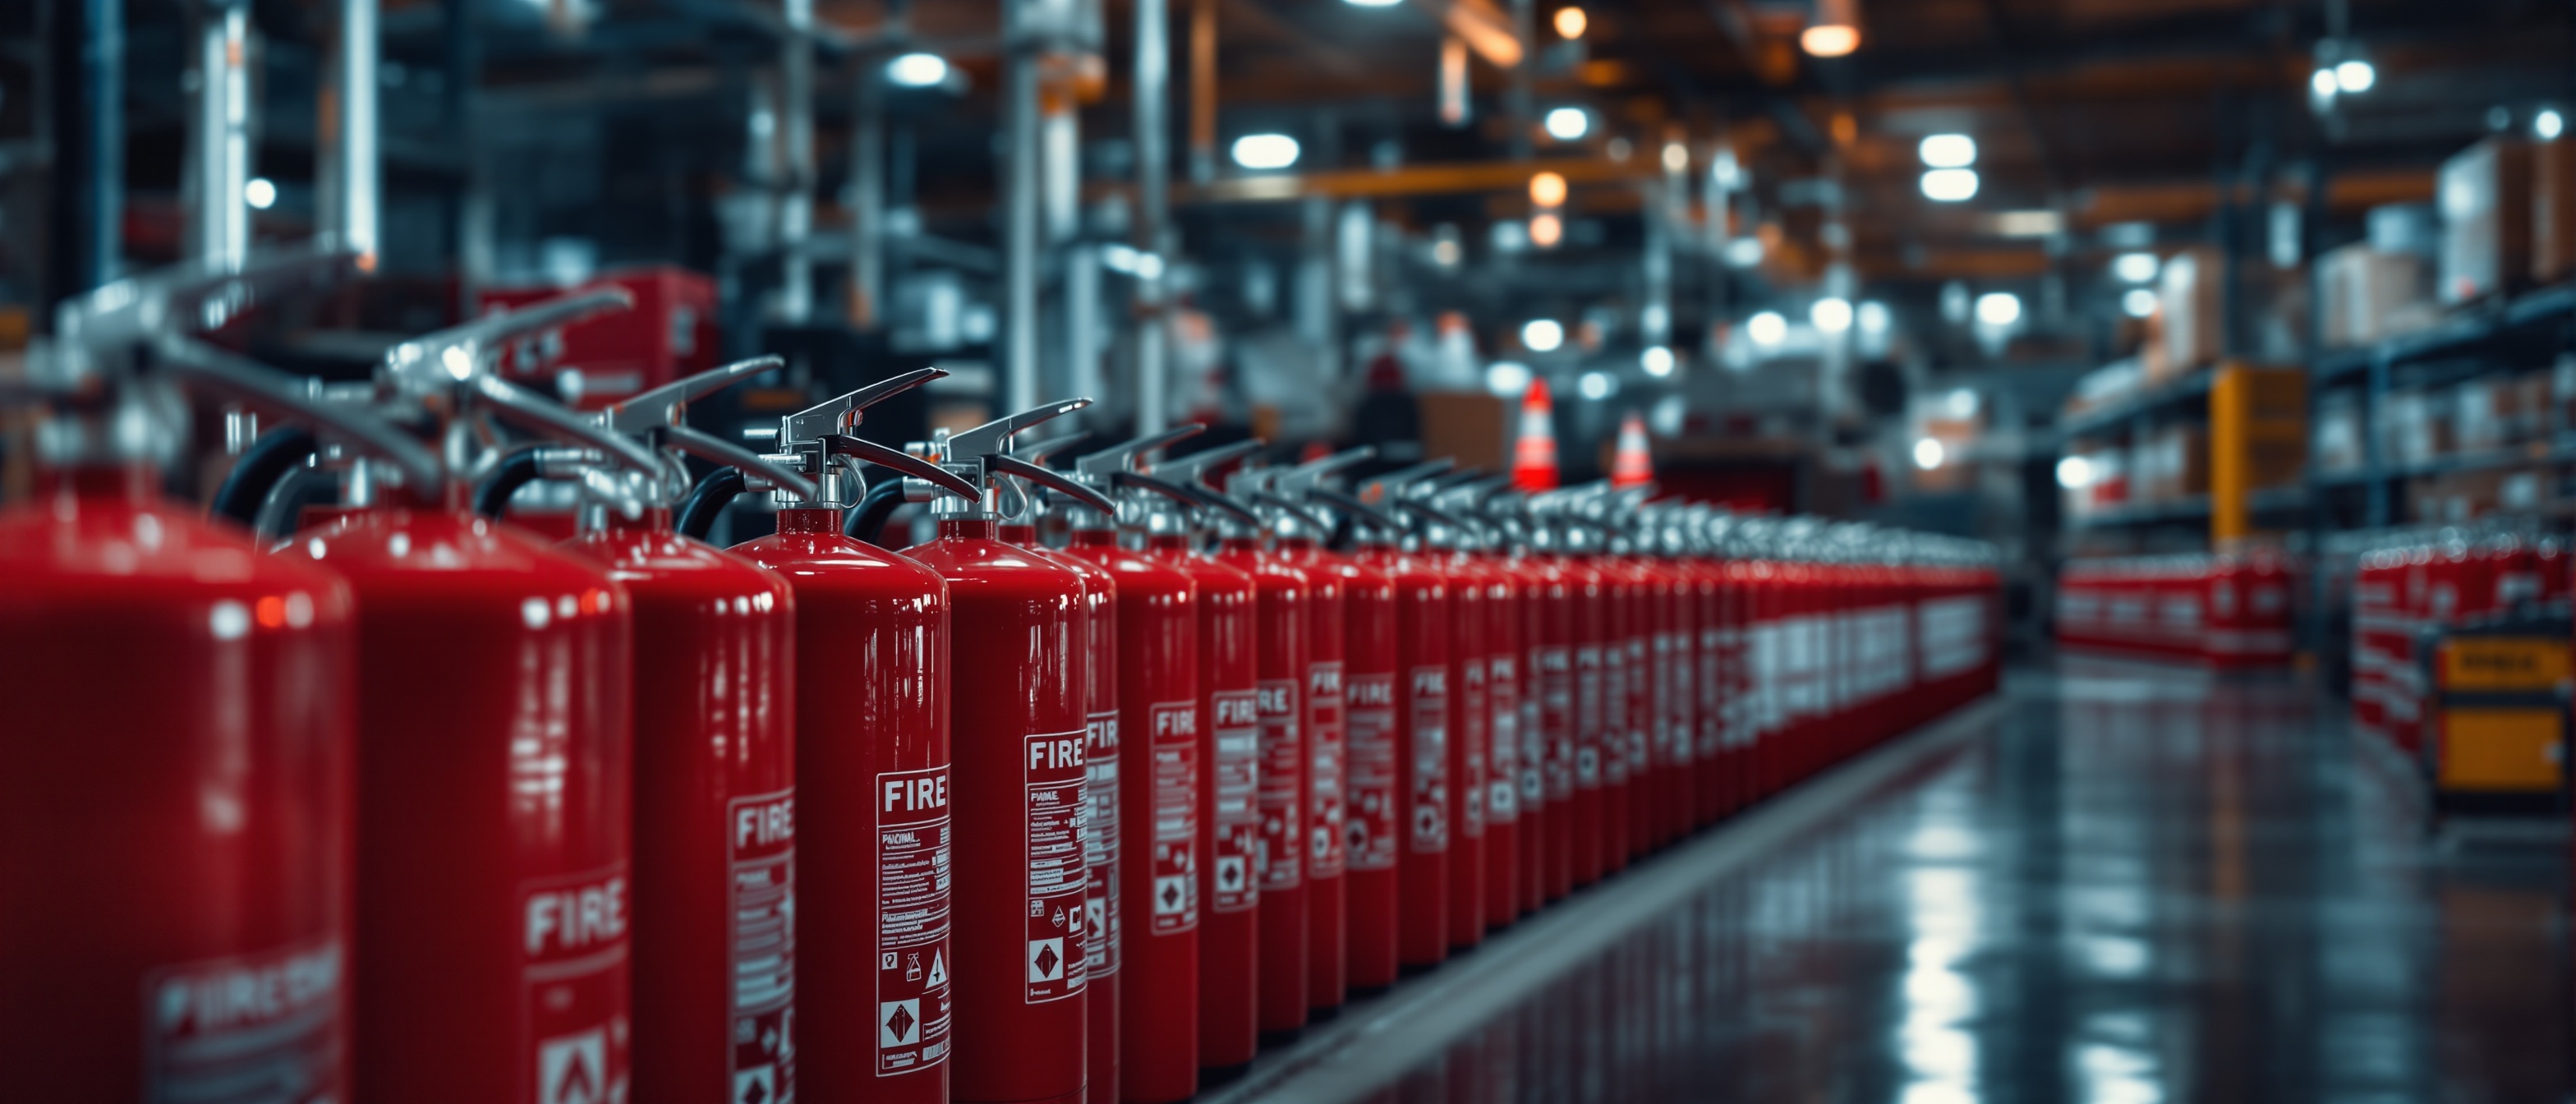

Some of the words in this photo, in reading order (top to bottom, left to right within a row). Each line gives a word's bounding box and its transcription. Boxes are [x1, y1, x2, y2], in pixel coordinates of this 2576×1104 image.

[1258, 688, 1287, 712] RE
[1087, 719, 1119, 748] FIR
[1031, 738, 1083, 770] FIRE
[886, 775, 946, 812] FIRE
[738, 799, 794, 847] FIRE
[527, 878, 625, 954] FIRE
